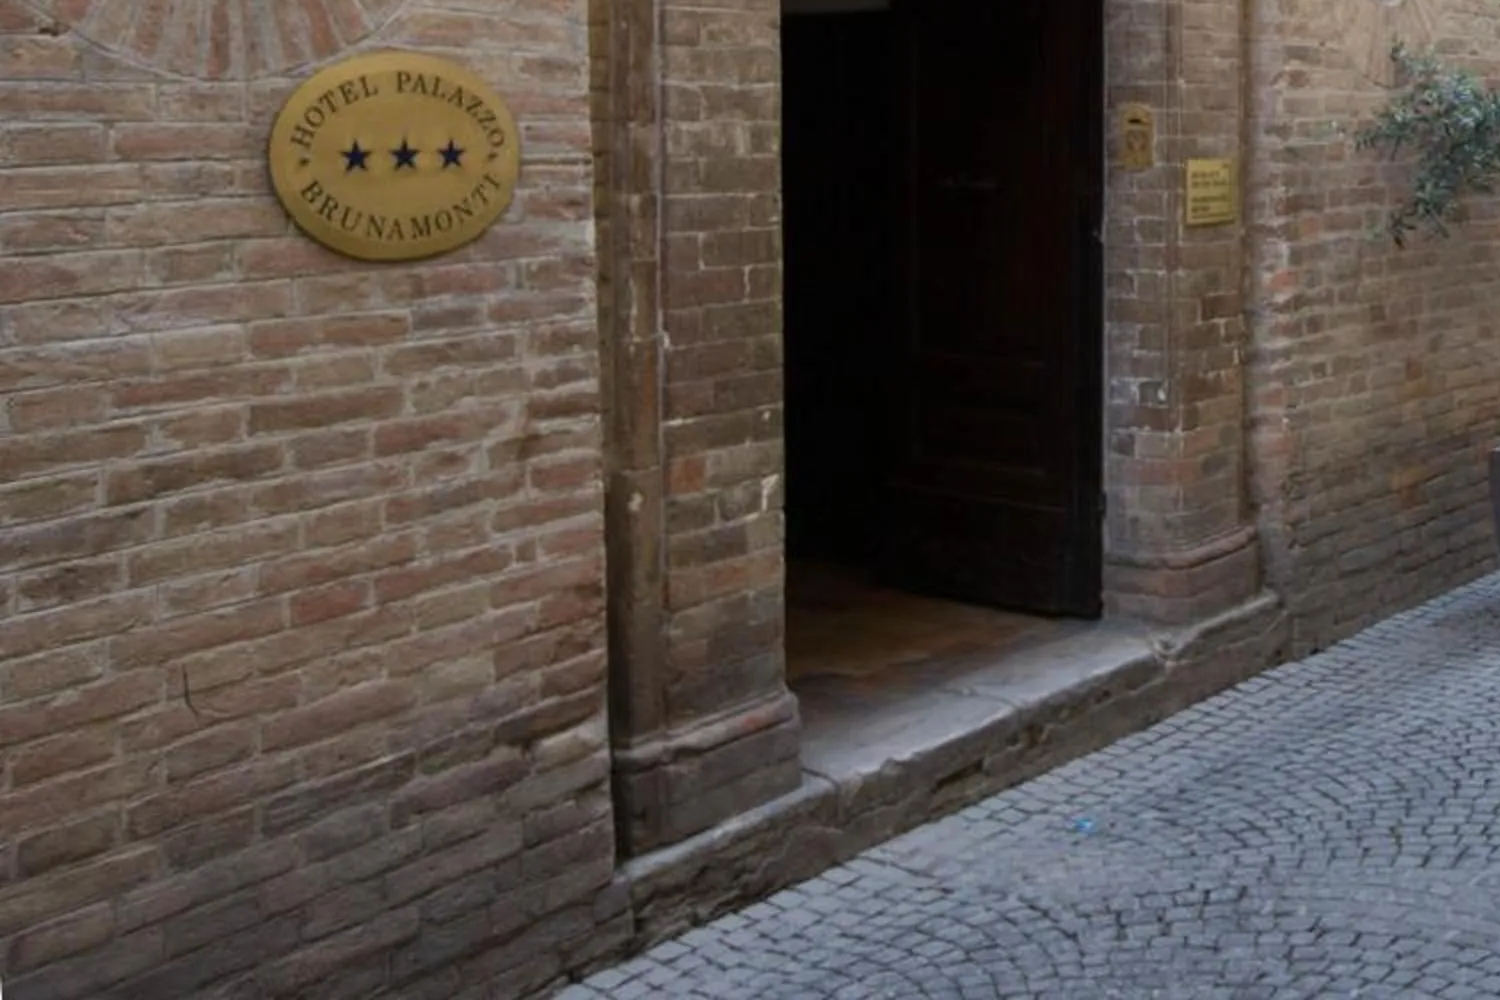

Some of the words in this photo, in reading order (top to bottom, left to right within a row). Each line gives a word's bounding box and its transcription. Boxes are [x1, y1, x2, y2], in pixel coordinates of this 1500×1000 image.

[290, 75, 379, 149] HOTEL
[395, 70, 505, 149] PALAZZO
[300, 172, 501, 241] BRUNAMONTI
